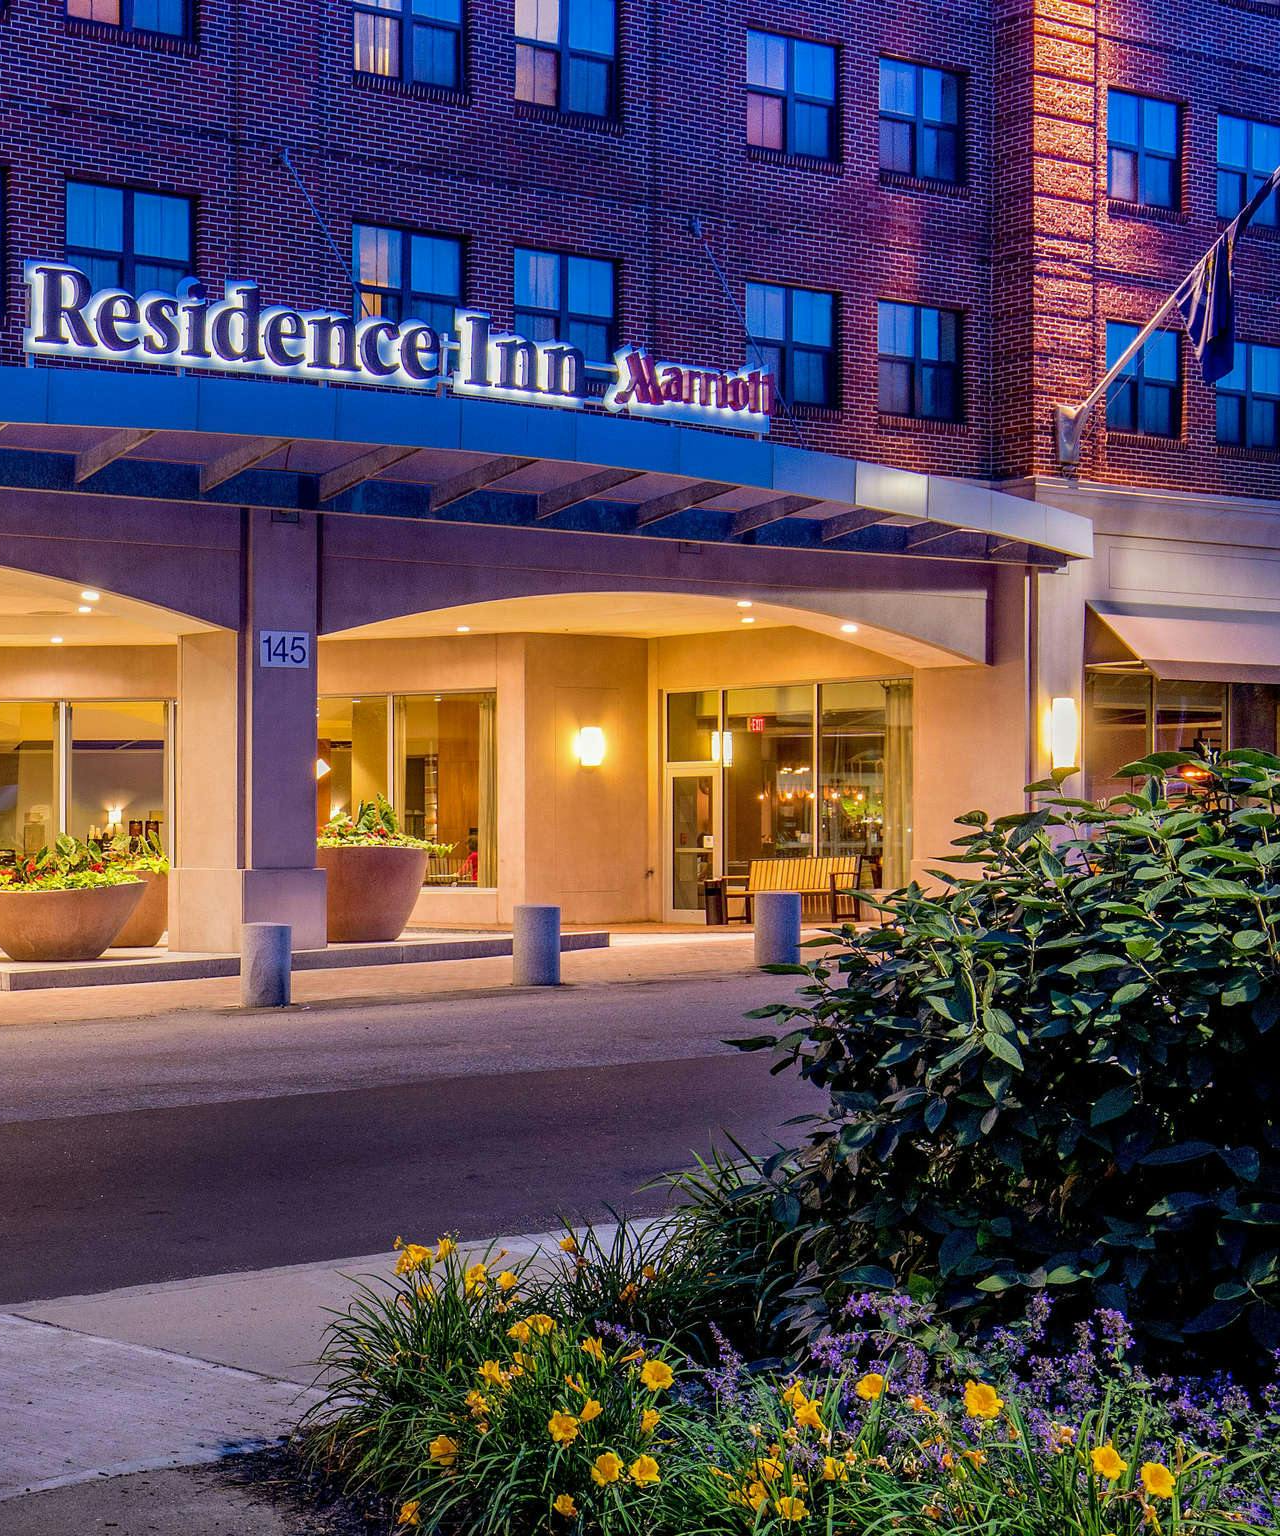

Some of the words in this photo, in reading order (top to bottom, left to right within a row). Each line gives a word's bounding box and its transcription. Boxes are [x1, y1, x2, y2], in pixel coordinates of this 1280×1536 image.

[34, 265, 441, 381] Residence
[464, 315, 588, 399] Inn
[614, 350, 777, 416] Marriott
[262, 635, 306, 664] 145
